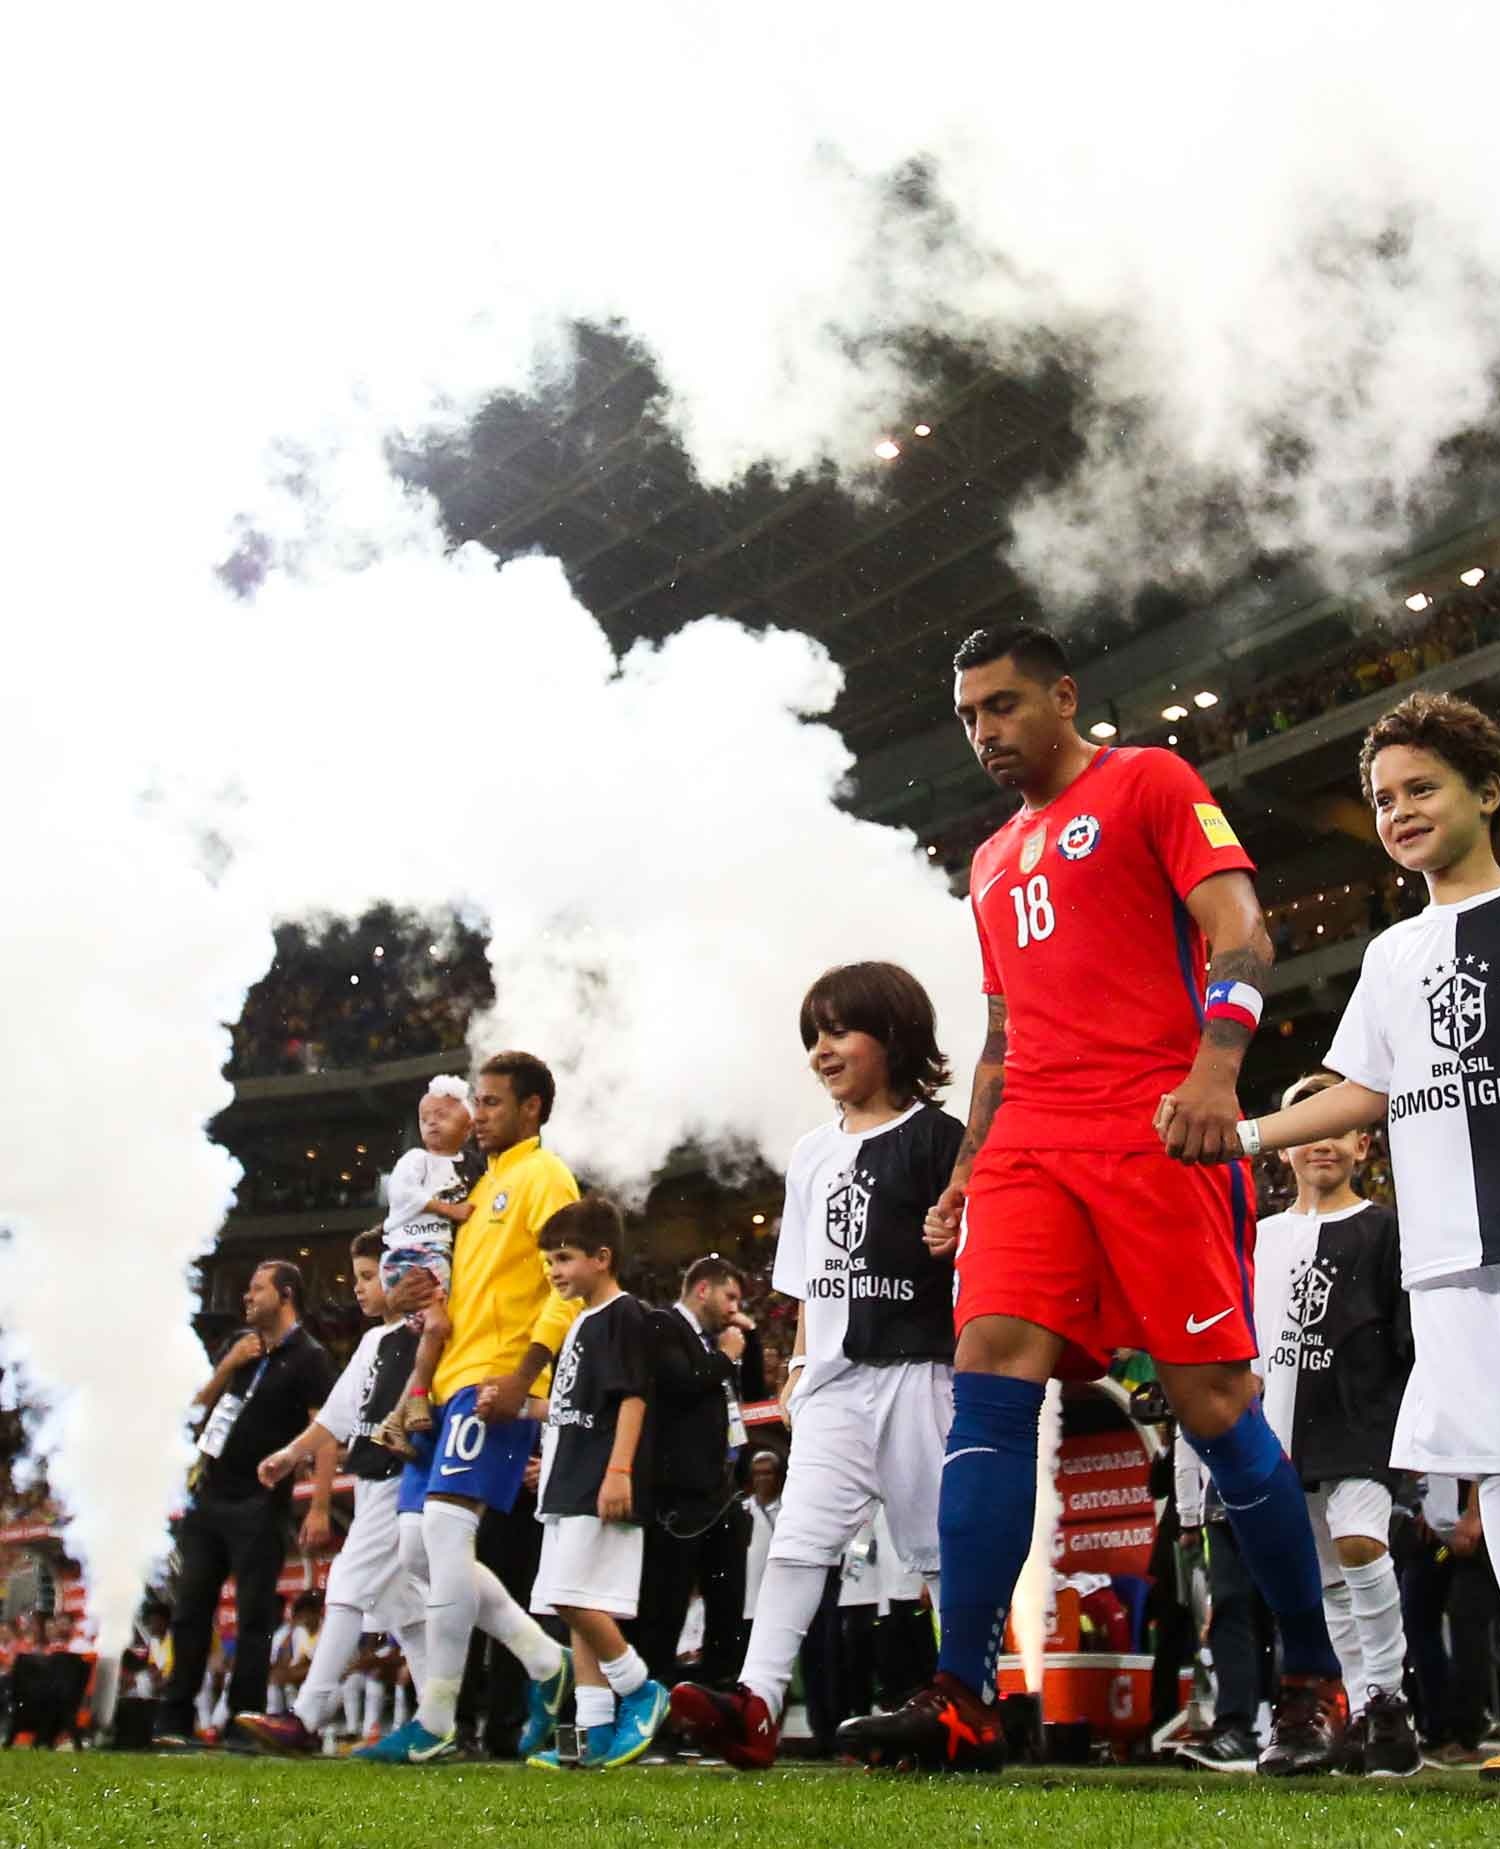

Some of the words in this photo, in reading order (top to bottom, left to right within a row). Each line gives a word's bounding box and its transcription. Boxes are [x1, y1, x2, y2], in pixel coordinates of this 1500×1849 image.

[1009, 874, 1056, 949] 18
[1431, 1056, 1495, 1078] BRASIL
[1390, 1083, 1460, 1124] SOMOS
[852, 1276, 914, 1300] IGUAIS
[1281, 1331, 1325, 1346] BRASIL
[443, 1413, 486, 1462] 10
[1063, 1449, 1146, 1475] GATORADE
[1070, 1527, 1154, 1552] GATORADE
